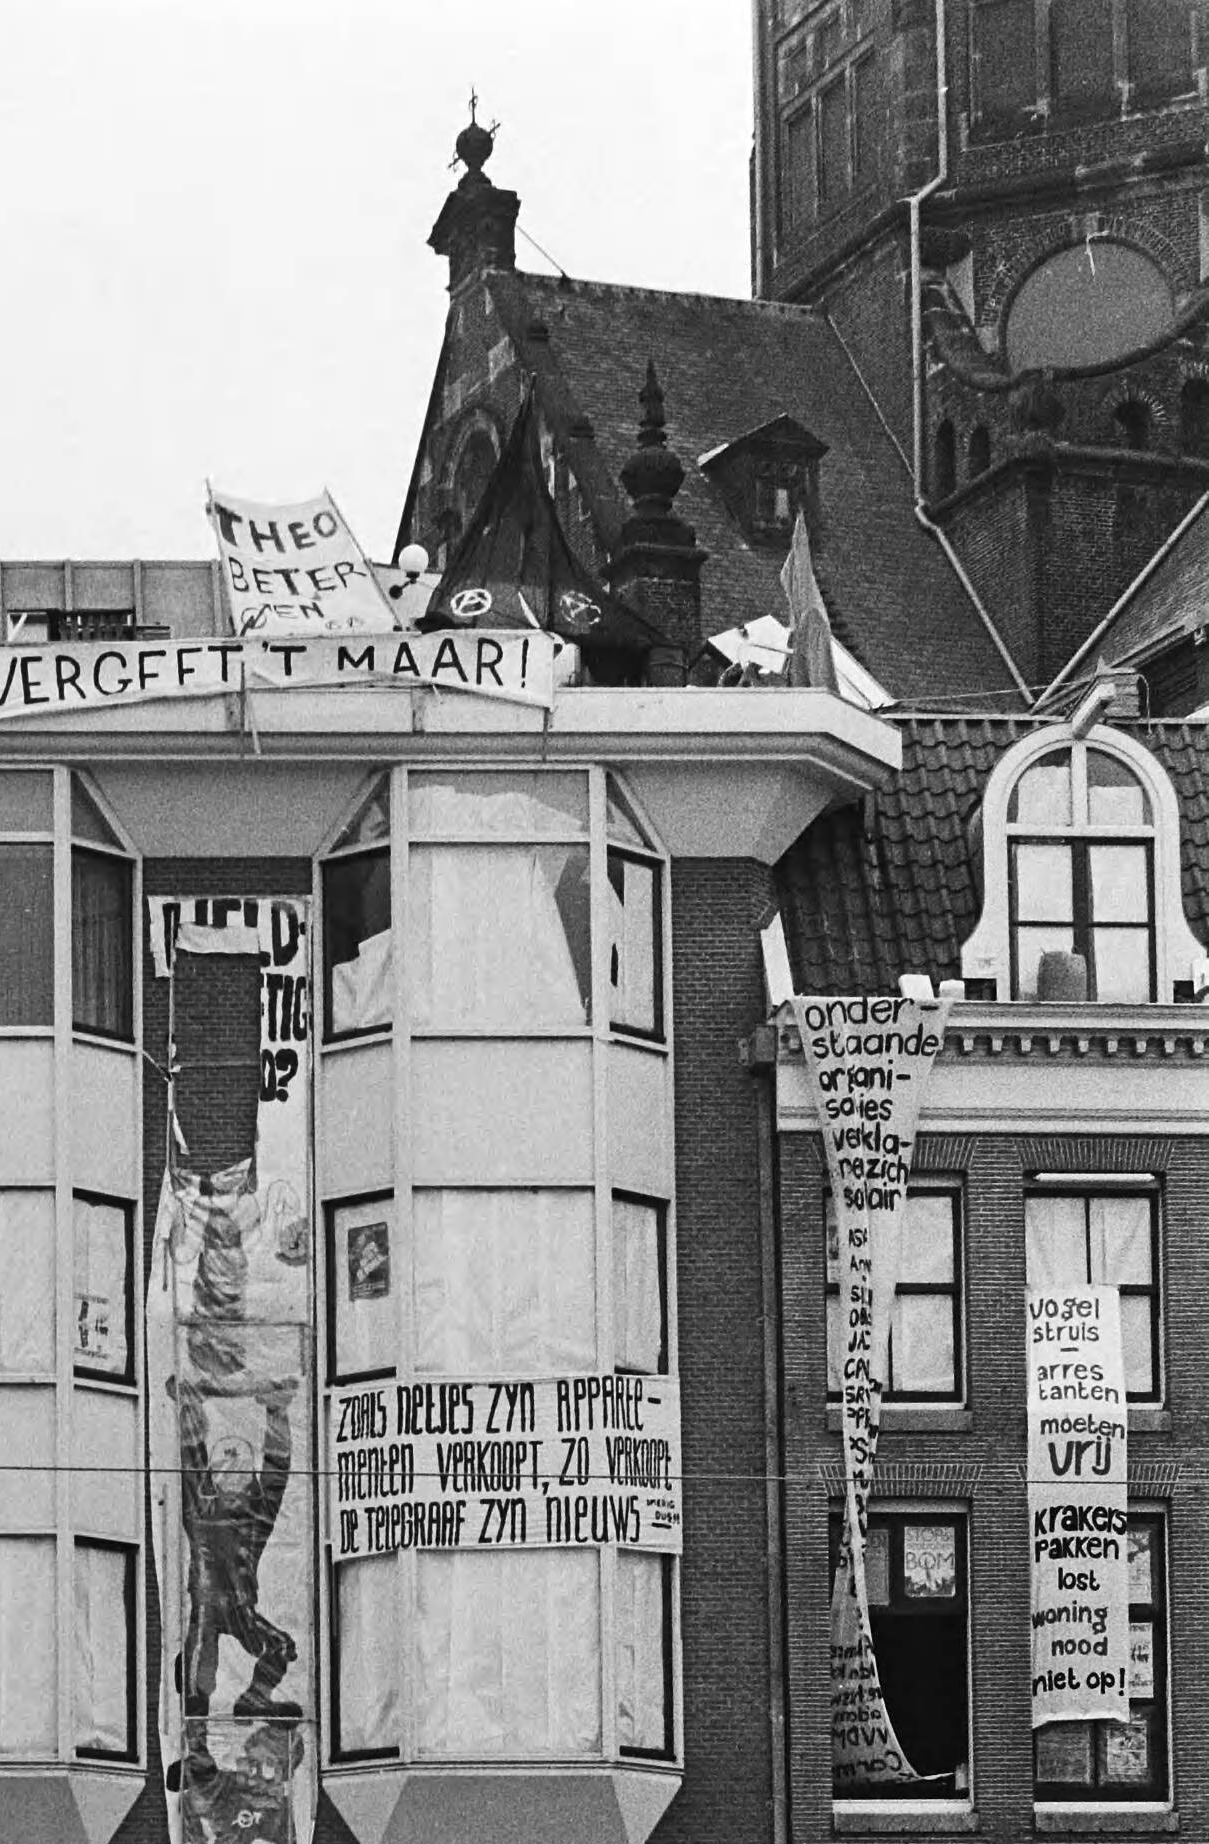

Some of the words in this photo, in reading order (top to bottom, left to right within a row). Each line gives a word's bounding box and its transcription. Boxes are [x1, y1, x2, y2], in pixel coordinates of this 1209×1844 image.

[215, 501, 338, 553] THEO
[228, 556, 367, 596] BETER
[338, 637, 528, 688] MAAR!
[805, 997, 939, 1031] onder-
[812, 1023, 939, 1059] staande
[1029, 1298, 1100, 1321] vogel
[1033, 1321, 1100, 1343] struis
[1037, 1363, 1104, 1381] arres
[1038, 1381, 1119, 1404] tanten
[1040, 1413, 1125, 1440] moeten
[559, 1437, 590, 1487] ZO
[1048, 1435, 1112, 1476] vrij
[1057, 1567, 1101, 1591] lost
[1032, 1600, 1109, 1635] woning
[1051, 1636, 1108, 1656] nood
[1032, 1667, 1081, 1696] niet
[1086, 1667, 1126, 1696] op!
